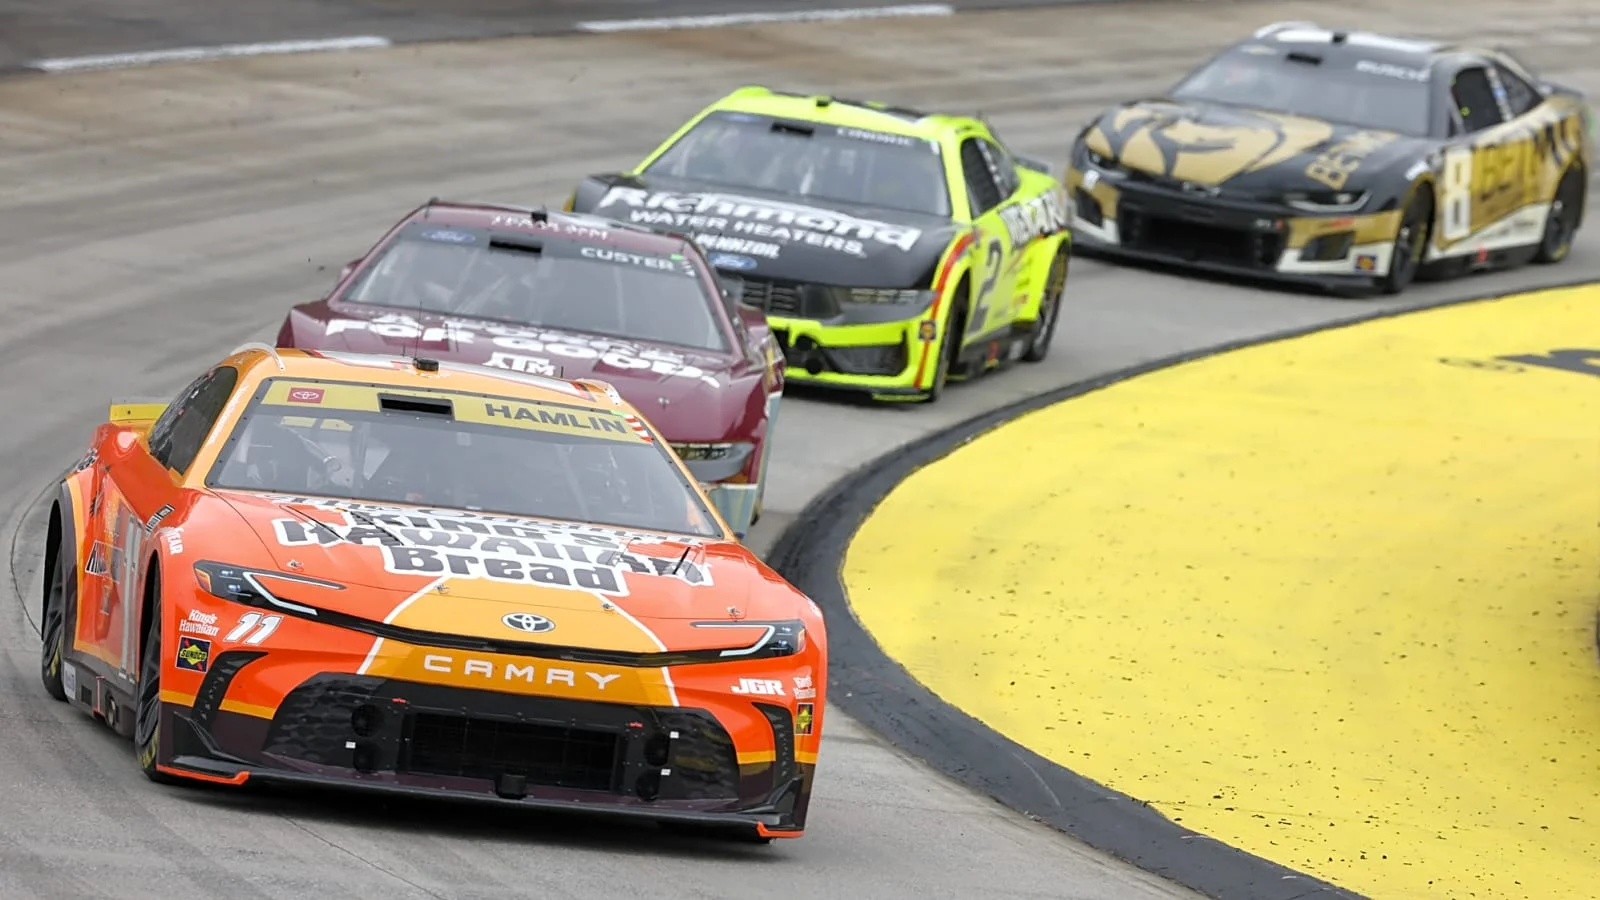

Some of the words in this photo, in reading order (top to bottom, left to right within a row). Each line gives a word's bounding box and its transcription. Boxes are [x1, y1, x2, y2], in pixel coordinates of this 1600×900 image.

[1443, 149, 1472, 240] 8
[600, 186, 922, 252] Richmond
[631, 210, 728, 230] WATER
[734, 221, 864, 254] HEATERS
[581, 247, 675, 271] CUSTER
[970, 239, 1002, 333] 2
[325, 318, 475, 344] FOR
[485, 403, 627, 434] HAMLIN
[392, 546, 621, 592] Bread
[179, 619, 220, 637] Hawaiian
[223, 611, 284, 646] 11
[180, 648, 208, 661] SUNOCO
[424, 654, 622, 690] CAMRY
[731, 678, 787, 696] JGR
